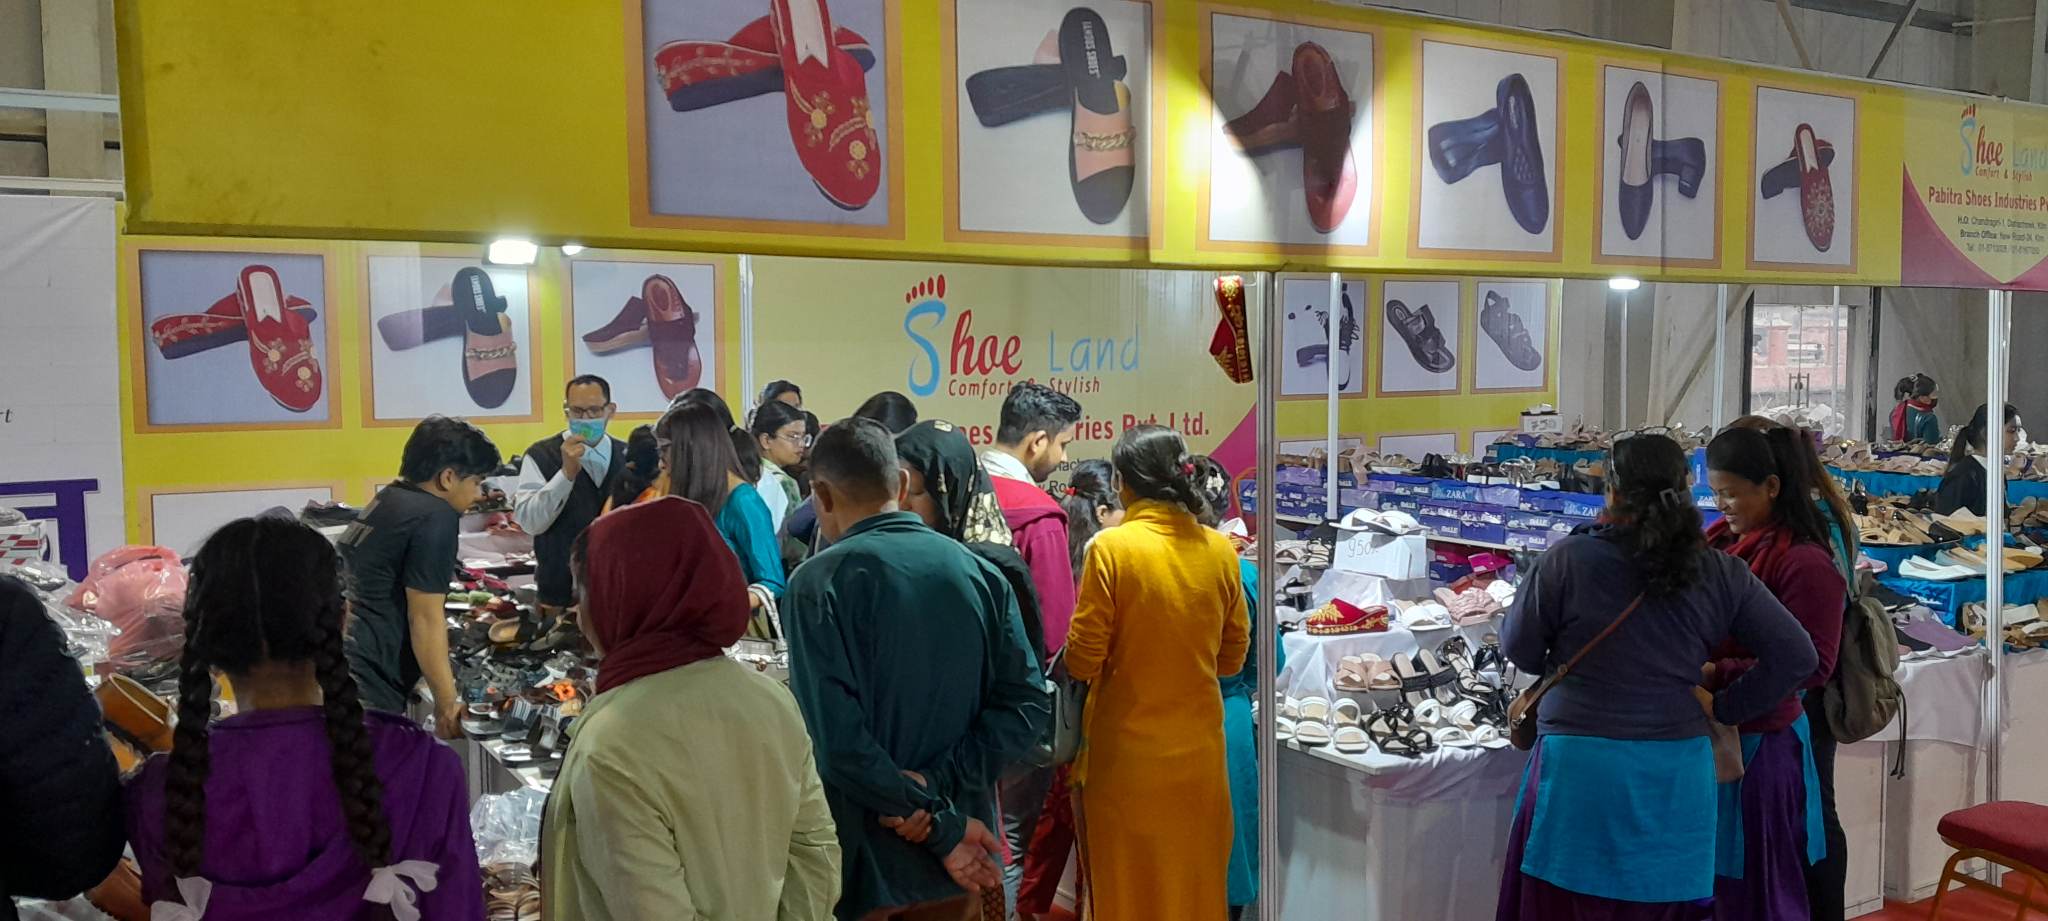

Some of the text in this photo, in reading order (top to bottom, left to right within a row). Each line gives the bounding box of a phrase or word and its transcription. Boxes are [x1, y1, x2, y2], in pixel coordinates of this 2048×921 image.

[1960, 118, 2004, 176] Shoe
[1976, 166, 2000, 179] Comfort
[2012, 169, 2033, 183] Stylish
[1928, 186, 1963, 205] Pabitra
[1965, 190, 1992, 208] Shoes
[1995, 191, 2037, 211] Industries
[904, 300, 1140, 397] Shoe Land
[948, 376, 1101, 400] Comfort Stylish
[1075, 415, 1114, 441] ries
[1446, 489, 1466, 500] ZARA
